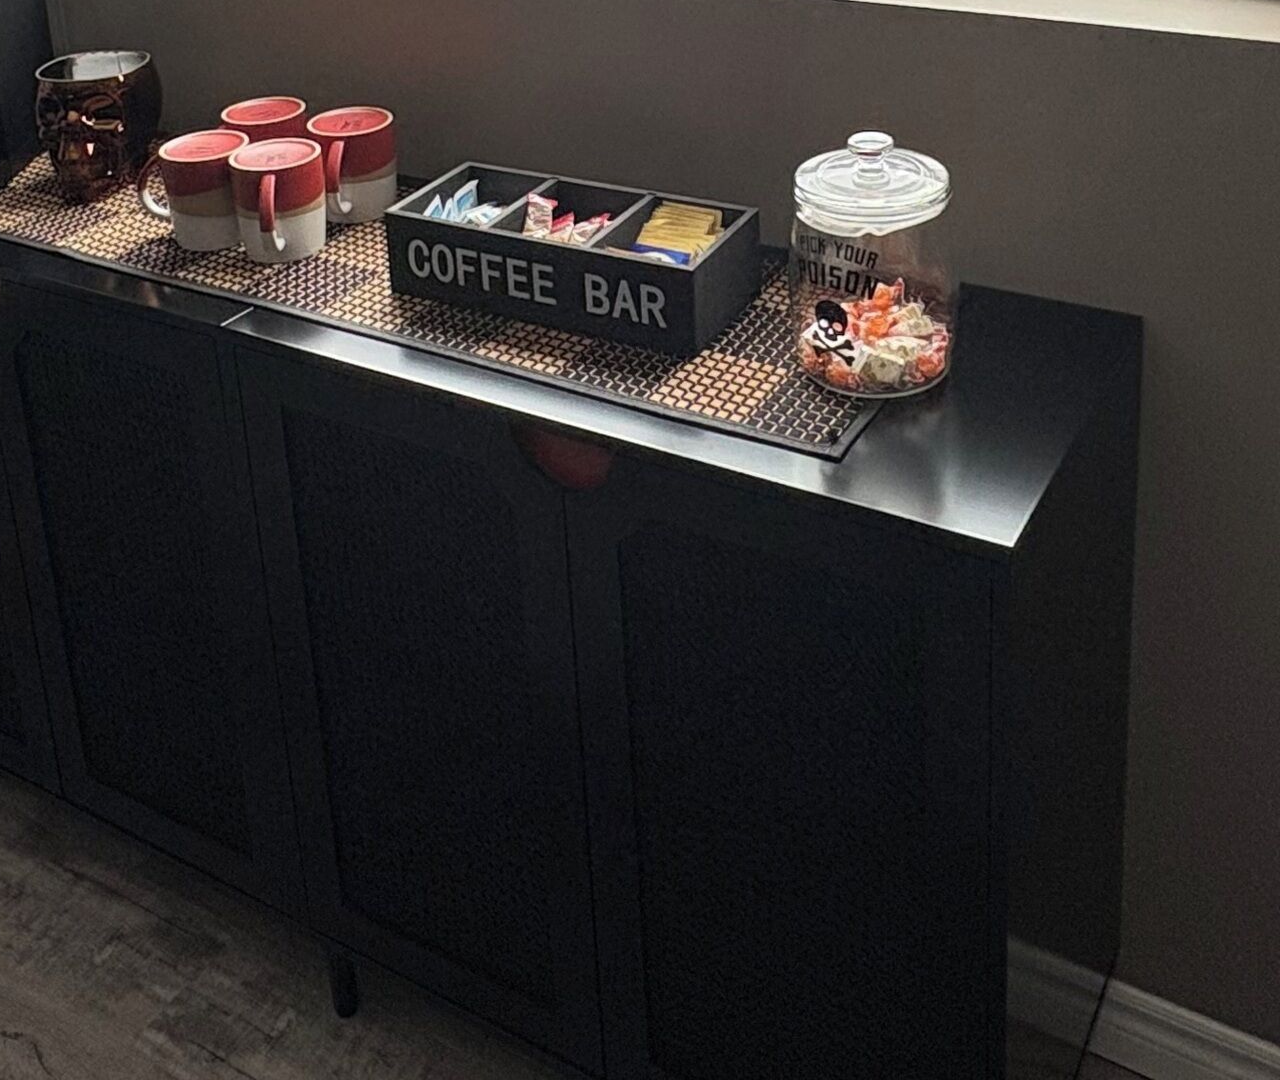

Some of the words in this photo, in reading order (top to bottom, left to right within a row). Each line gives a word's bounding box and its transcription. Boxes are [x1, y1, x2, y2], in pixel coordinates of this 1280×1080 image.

[799, 235, 826, 255] PICK
[834, 240, 879, 269] YOUR
[408, 238, 558, 305] COFFEE
[584, 273, 668, 329] BAR
[799, 258, 879, 300] POISON
